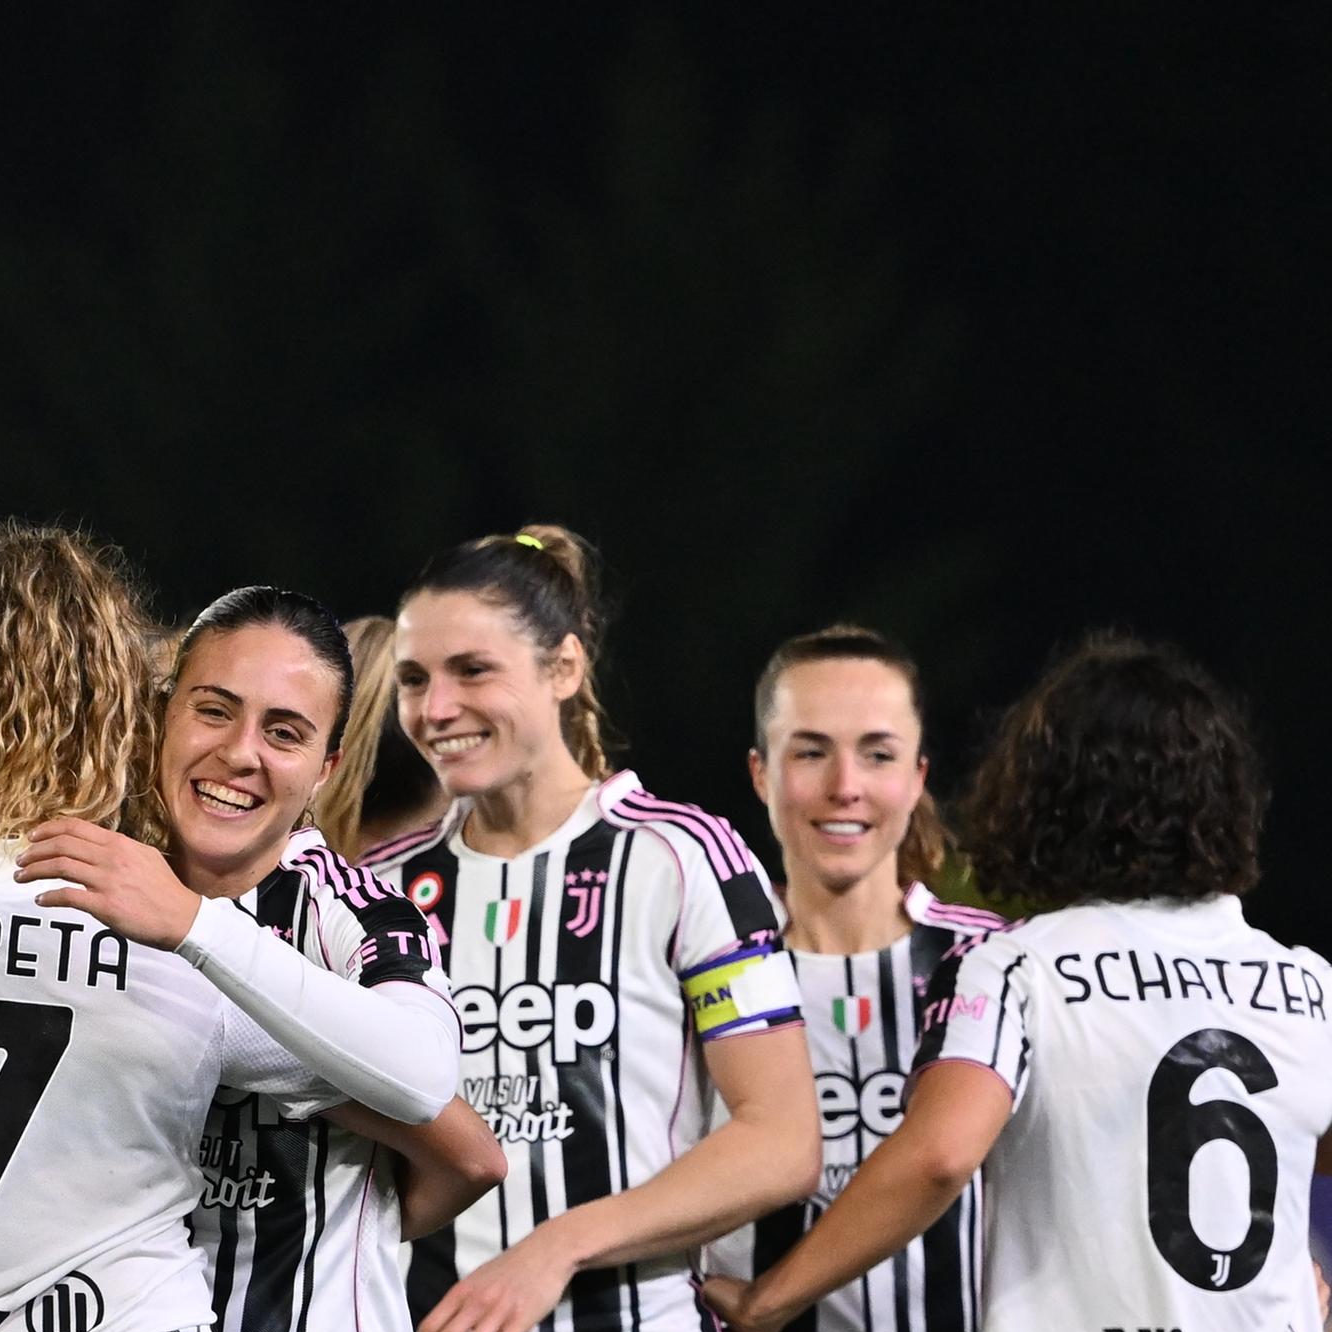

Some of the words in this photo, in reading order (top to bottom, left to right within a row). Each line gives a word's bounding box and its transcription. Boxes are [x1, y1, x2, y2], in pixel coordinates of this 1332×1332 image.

[1054, 949, 1327, 1021] SCHATZER
[453, 980, 619, 1065] eep
[464, 1075, 539, 1106] VISIT
[482, 1101, 575, 1143] troit
[1147, 1028, 1279, 1292] 6
